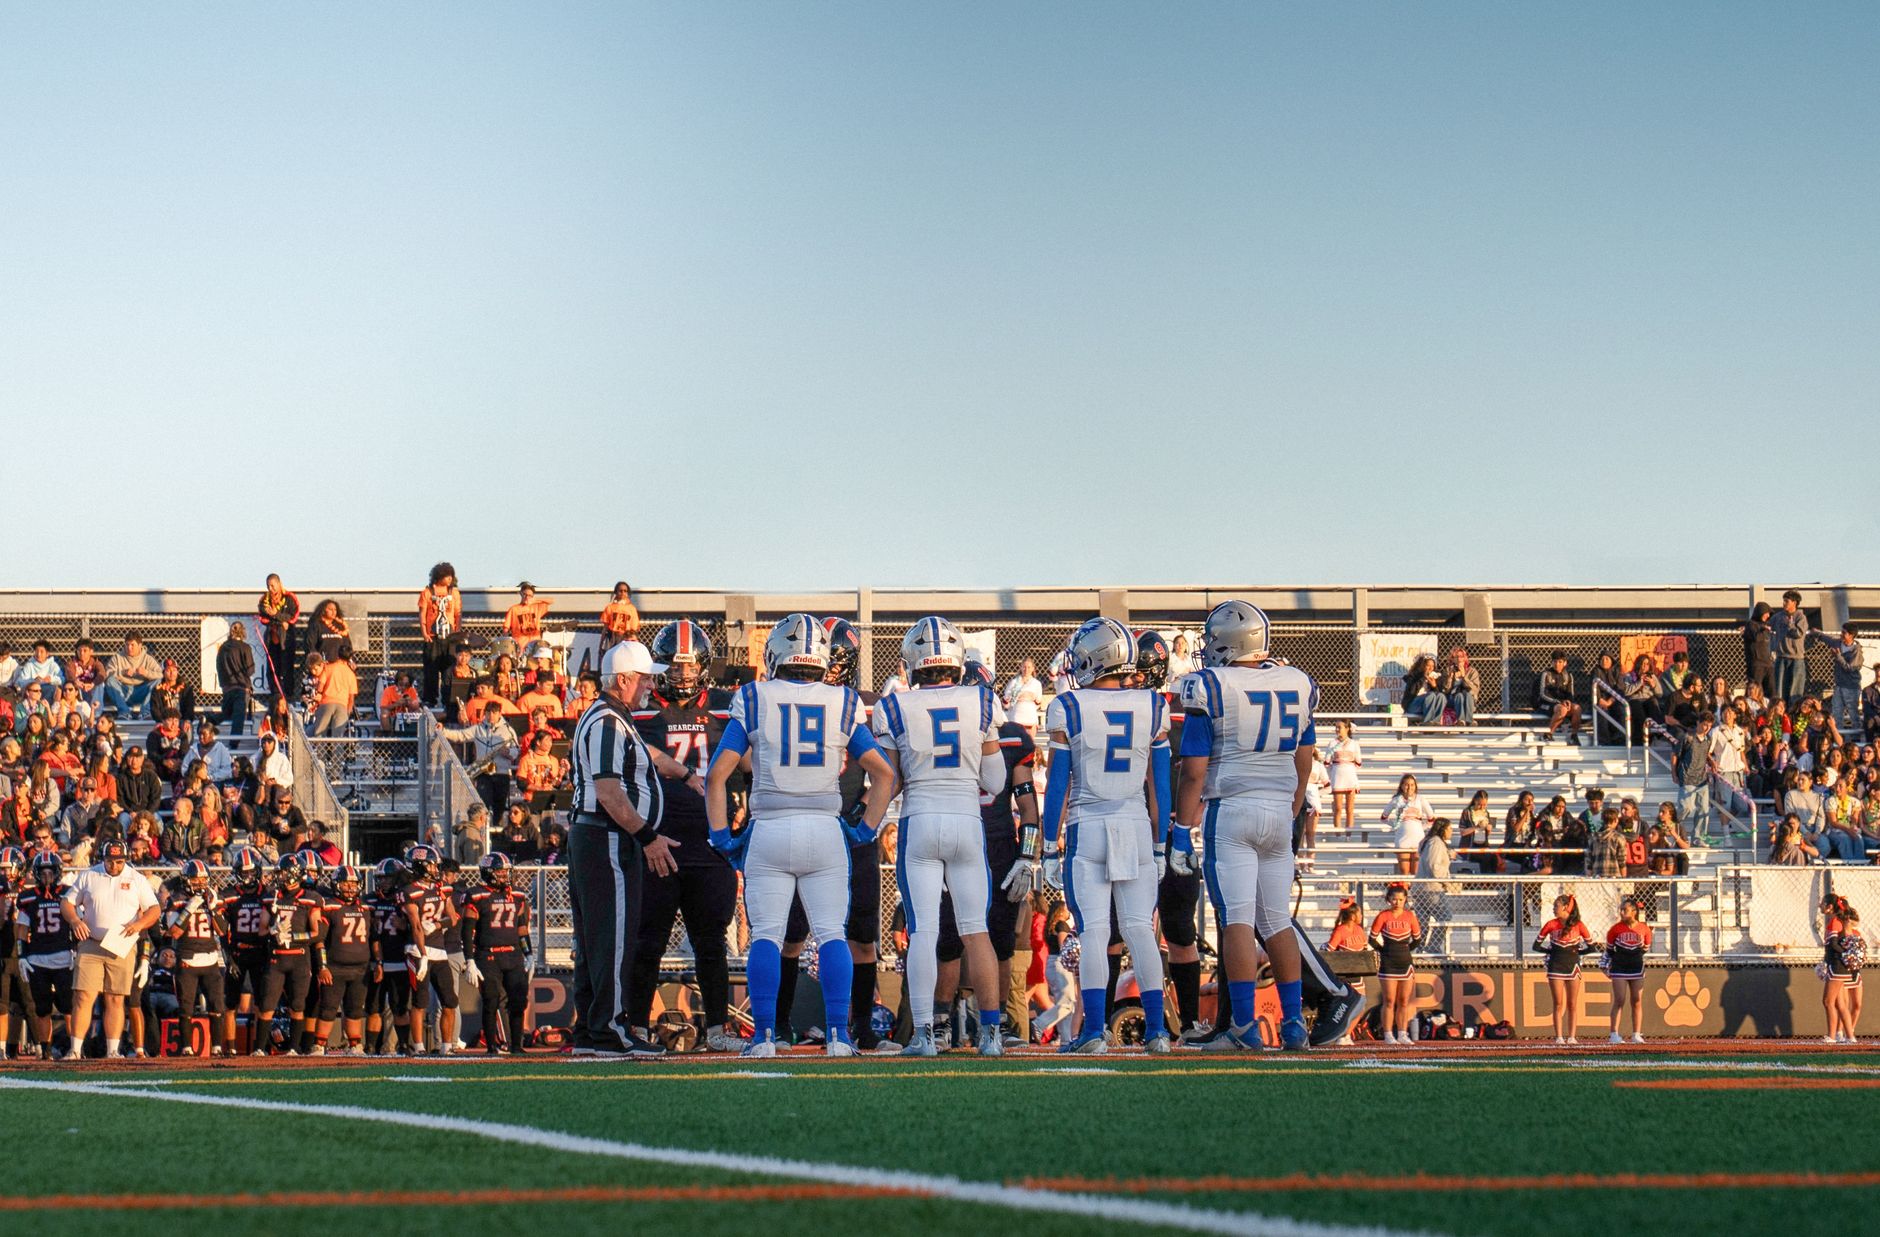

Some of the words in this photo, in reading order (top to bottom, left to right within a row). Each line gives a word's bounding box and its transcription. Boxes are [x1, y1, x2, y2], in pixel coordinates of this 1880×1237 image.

[792, 655, 822, 665] Riddell
[923, 656, 953, 666] Riddell
[668, 724, 705, 732] BEARCATS
[778, 703, 826, 767] 19
[1244, 690, 1300, 752] 75
[926, 706, 961, 769] 5
[1103, 710, 1134, 773] 2
[666, 733, 709, 777] 71
[36, 908, 60, 934] 15
[188, 911, 212, 939] 12
[236, 908, 263, 933] 22
[490, 903, 517, 928] 77
[341, 916, 367, 944] 74
[1332, 1003, 1348, 1024] HOKA
[1408, 972, 1613, 1028] PRIDE
